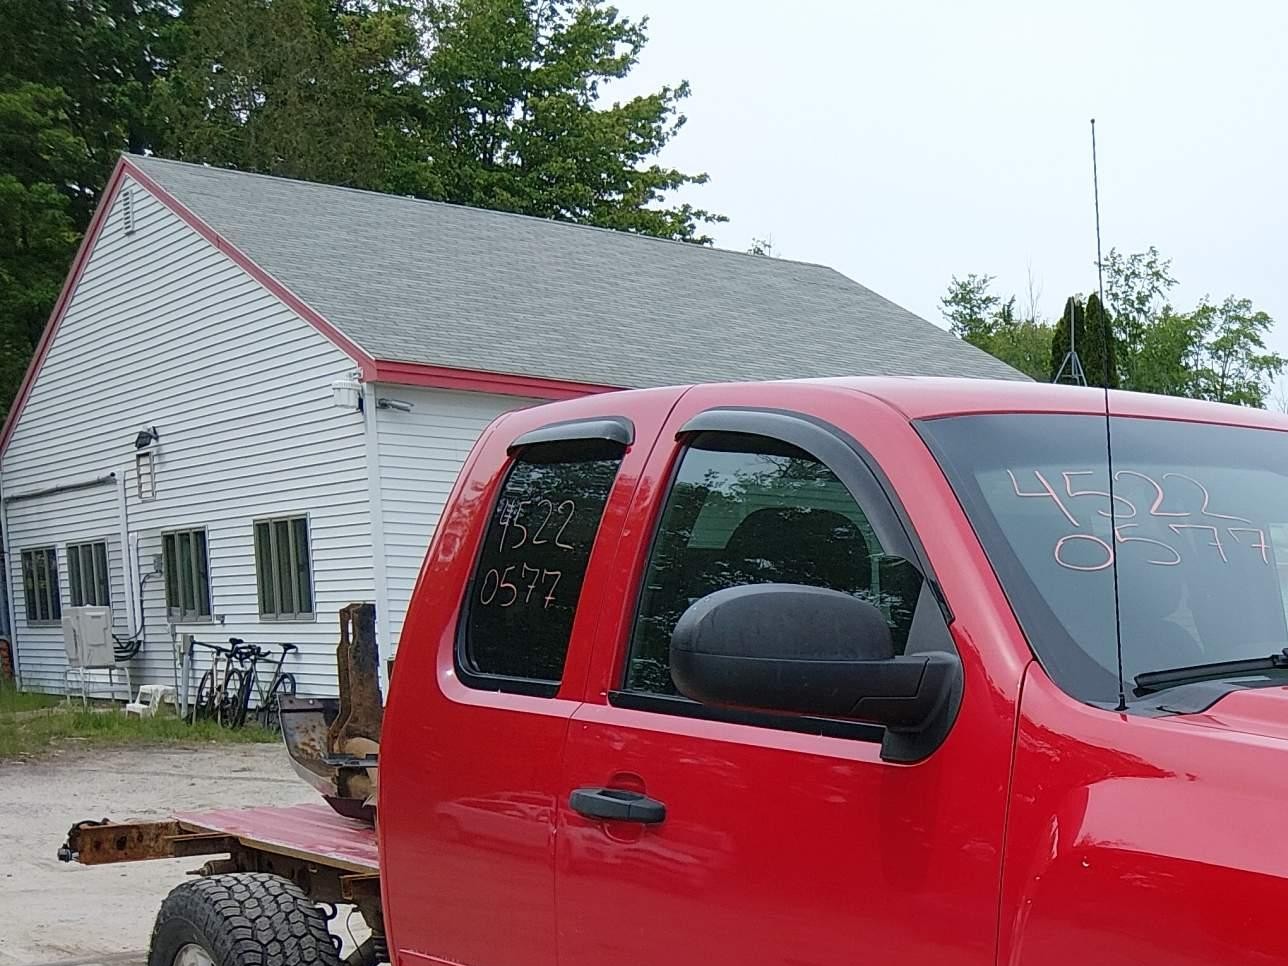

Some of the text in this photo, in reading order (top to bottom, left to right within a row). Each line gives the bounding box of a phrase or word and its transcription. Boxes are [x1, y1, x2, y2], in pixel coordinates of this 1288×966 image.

[1007, 469, 1253, 527] 4522
[498, 498, 575, 553] 4522
[1054, 523, 1270, 571] 0577
[480, 562, 562, 608] 0577
